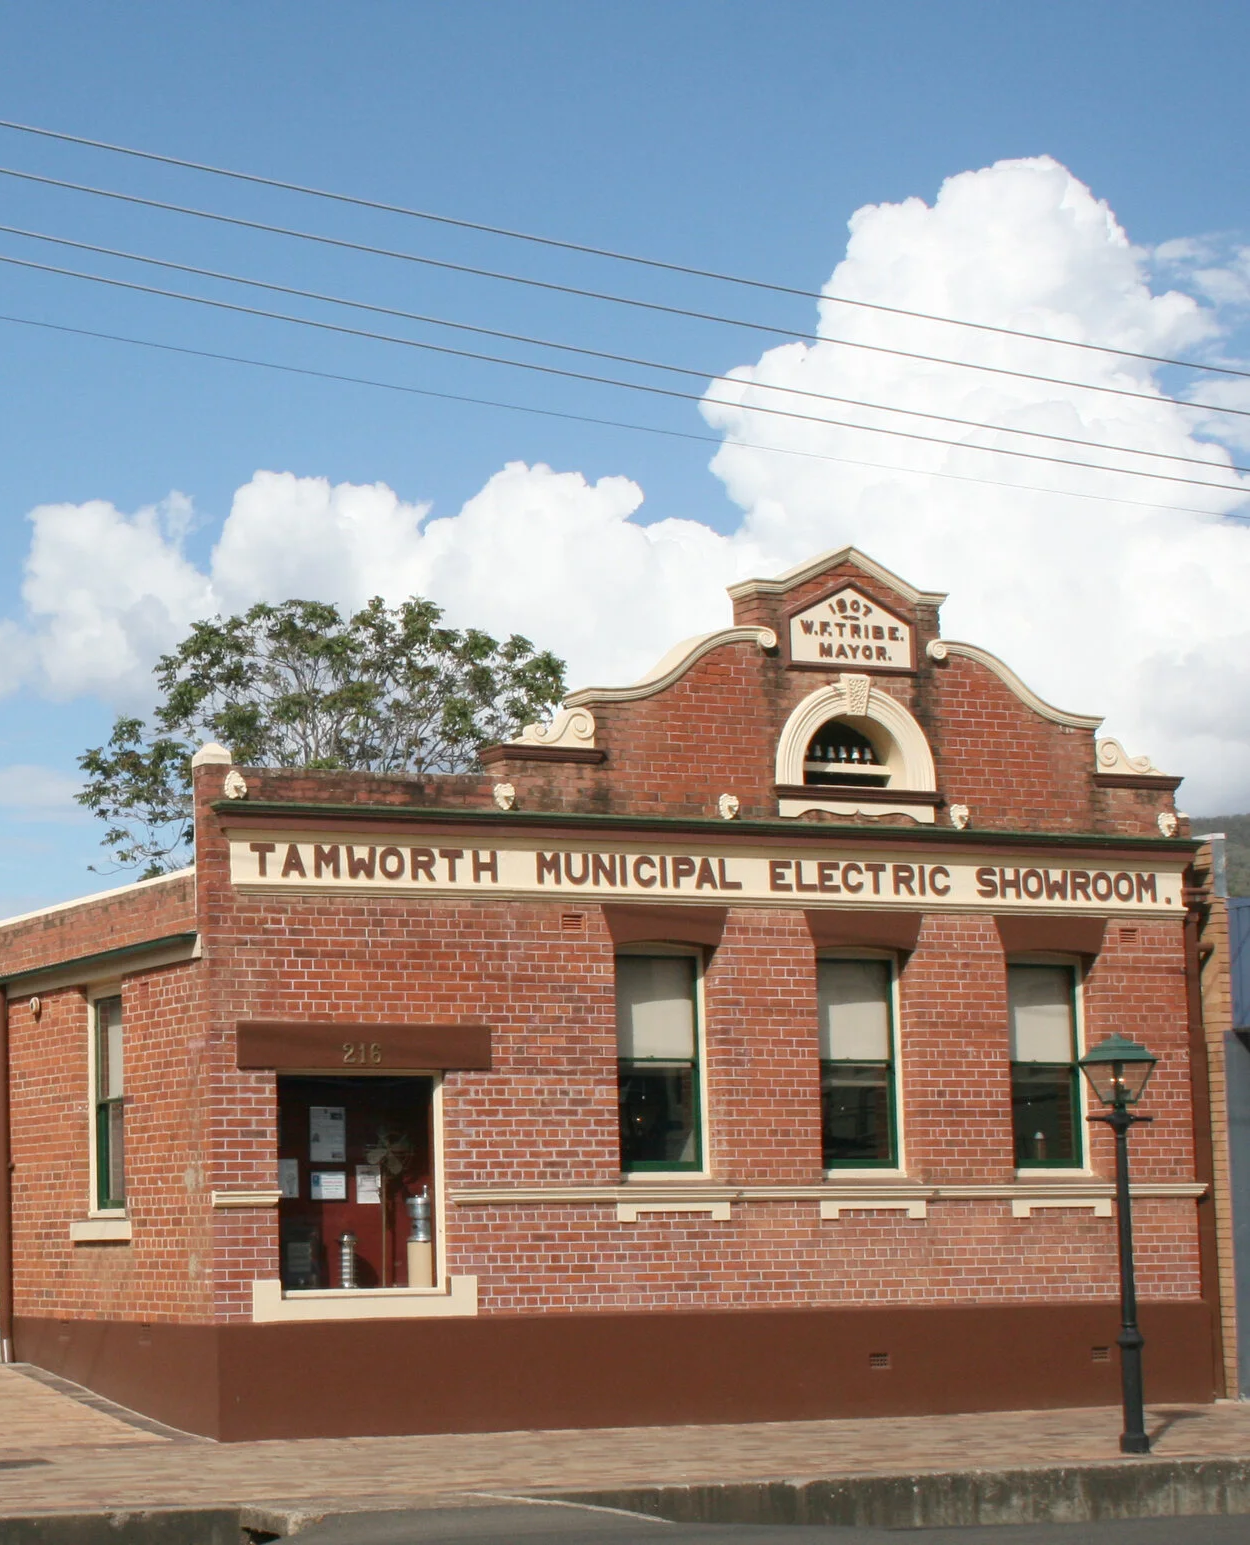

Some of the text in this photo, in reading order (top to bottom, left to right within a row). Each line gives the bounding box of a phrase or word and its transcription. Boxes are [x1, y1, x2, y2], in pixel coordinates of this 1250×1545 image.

[828, 598, 872, 617] 1907
[250, 843, 498, 883] TAMWORTH
[537, 852, 742, 890] MUNICIPAL
[769, 860, 951, 896] ELECTRIC
[342, 1042, 383, 1064] 216
